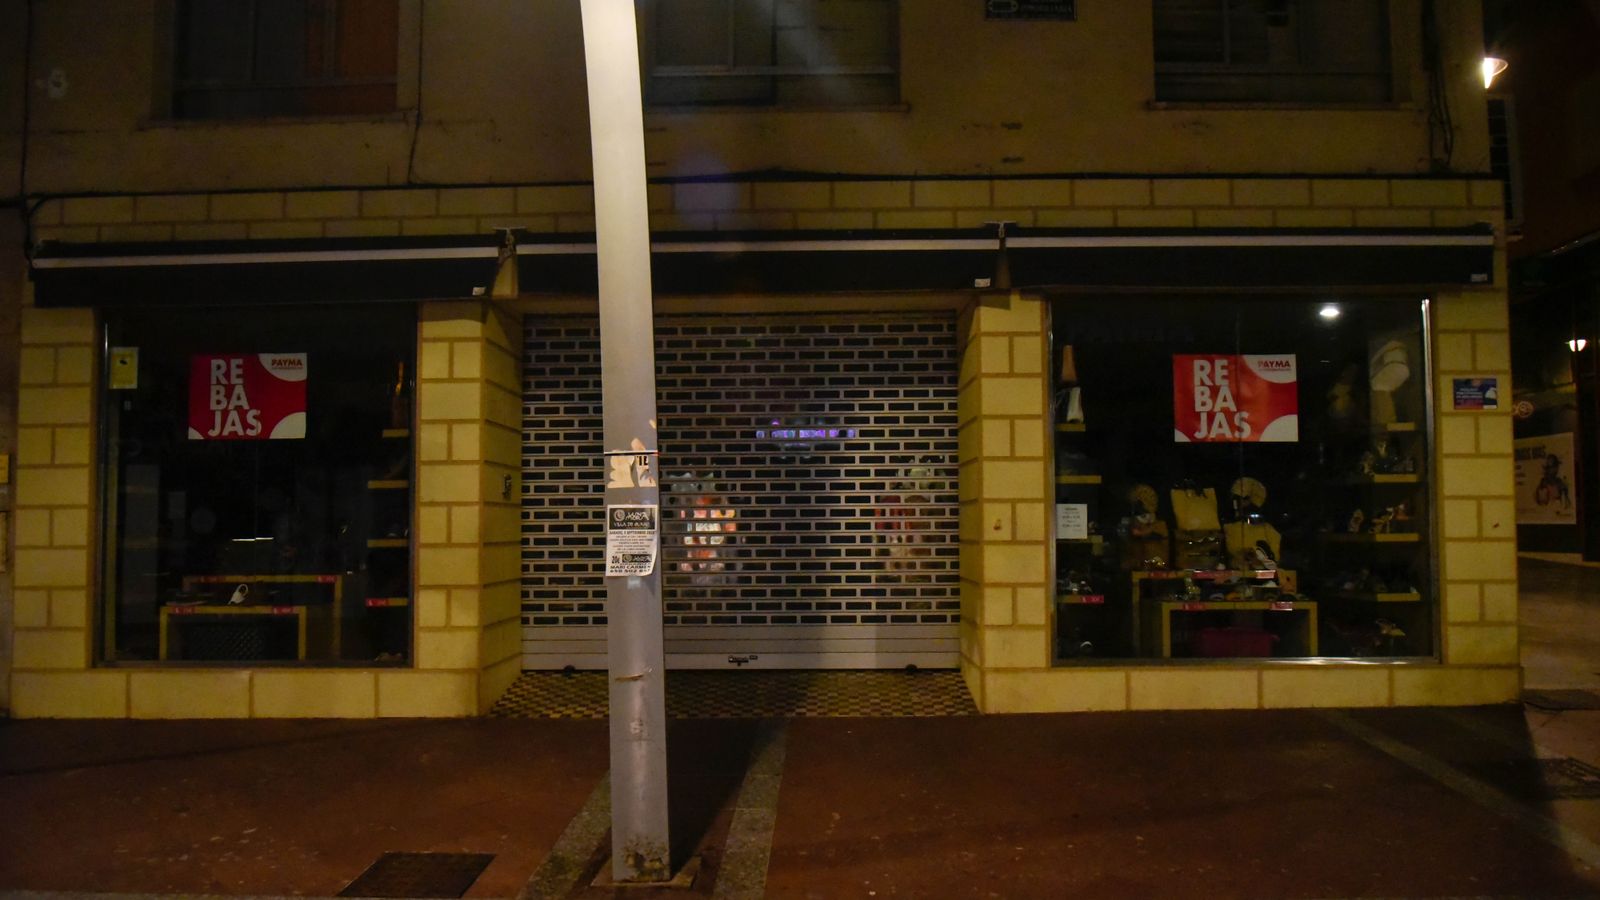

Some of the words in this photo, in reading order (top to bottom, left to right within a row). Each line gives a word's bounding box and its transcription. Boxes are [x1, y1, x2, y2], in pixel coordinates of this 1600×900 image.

[211, 359, 243, 384] RE
[271, 358, 303, 366] PAYMA
[1193, 359, 1229, 386] RE
[1258, 360, 1291, 368] PAYMA
[210, 385, 250, 410] BA
[1194, 386, 1237, 411] BA
[208, 409, 262, 437] JAS
[1193, 411, 1251, 439] JAS
